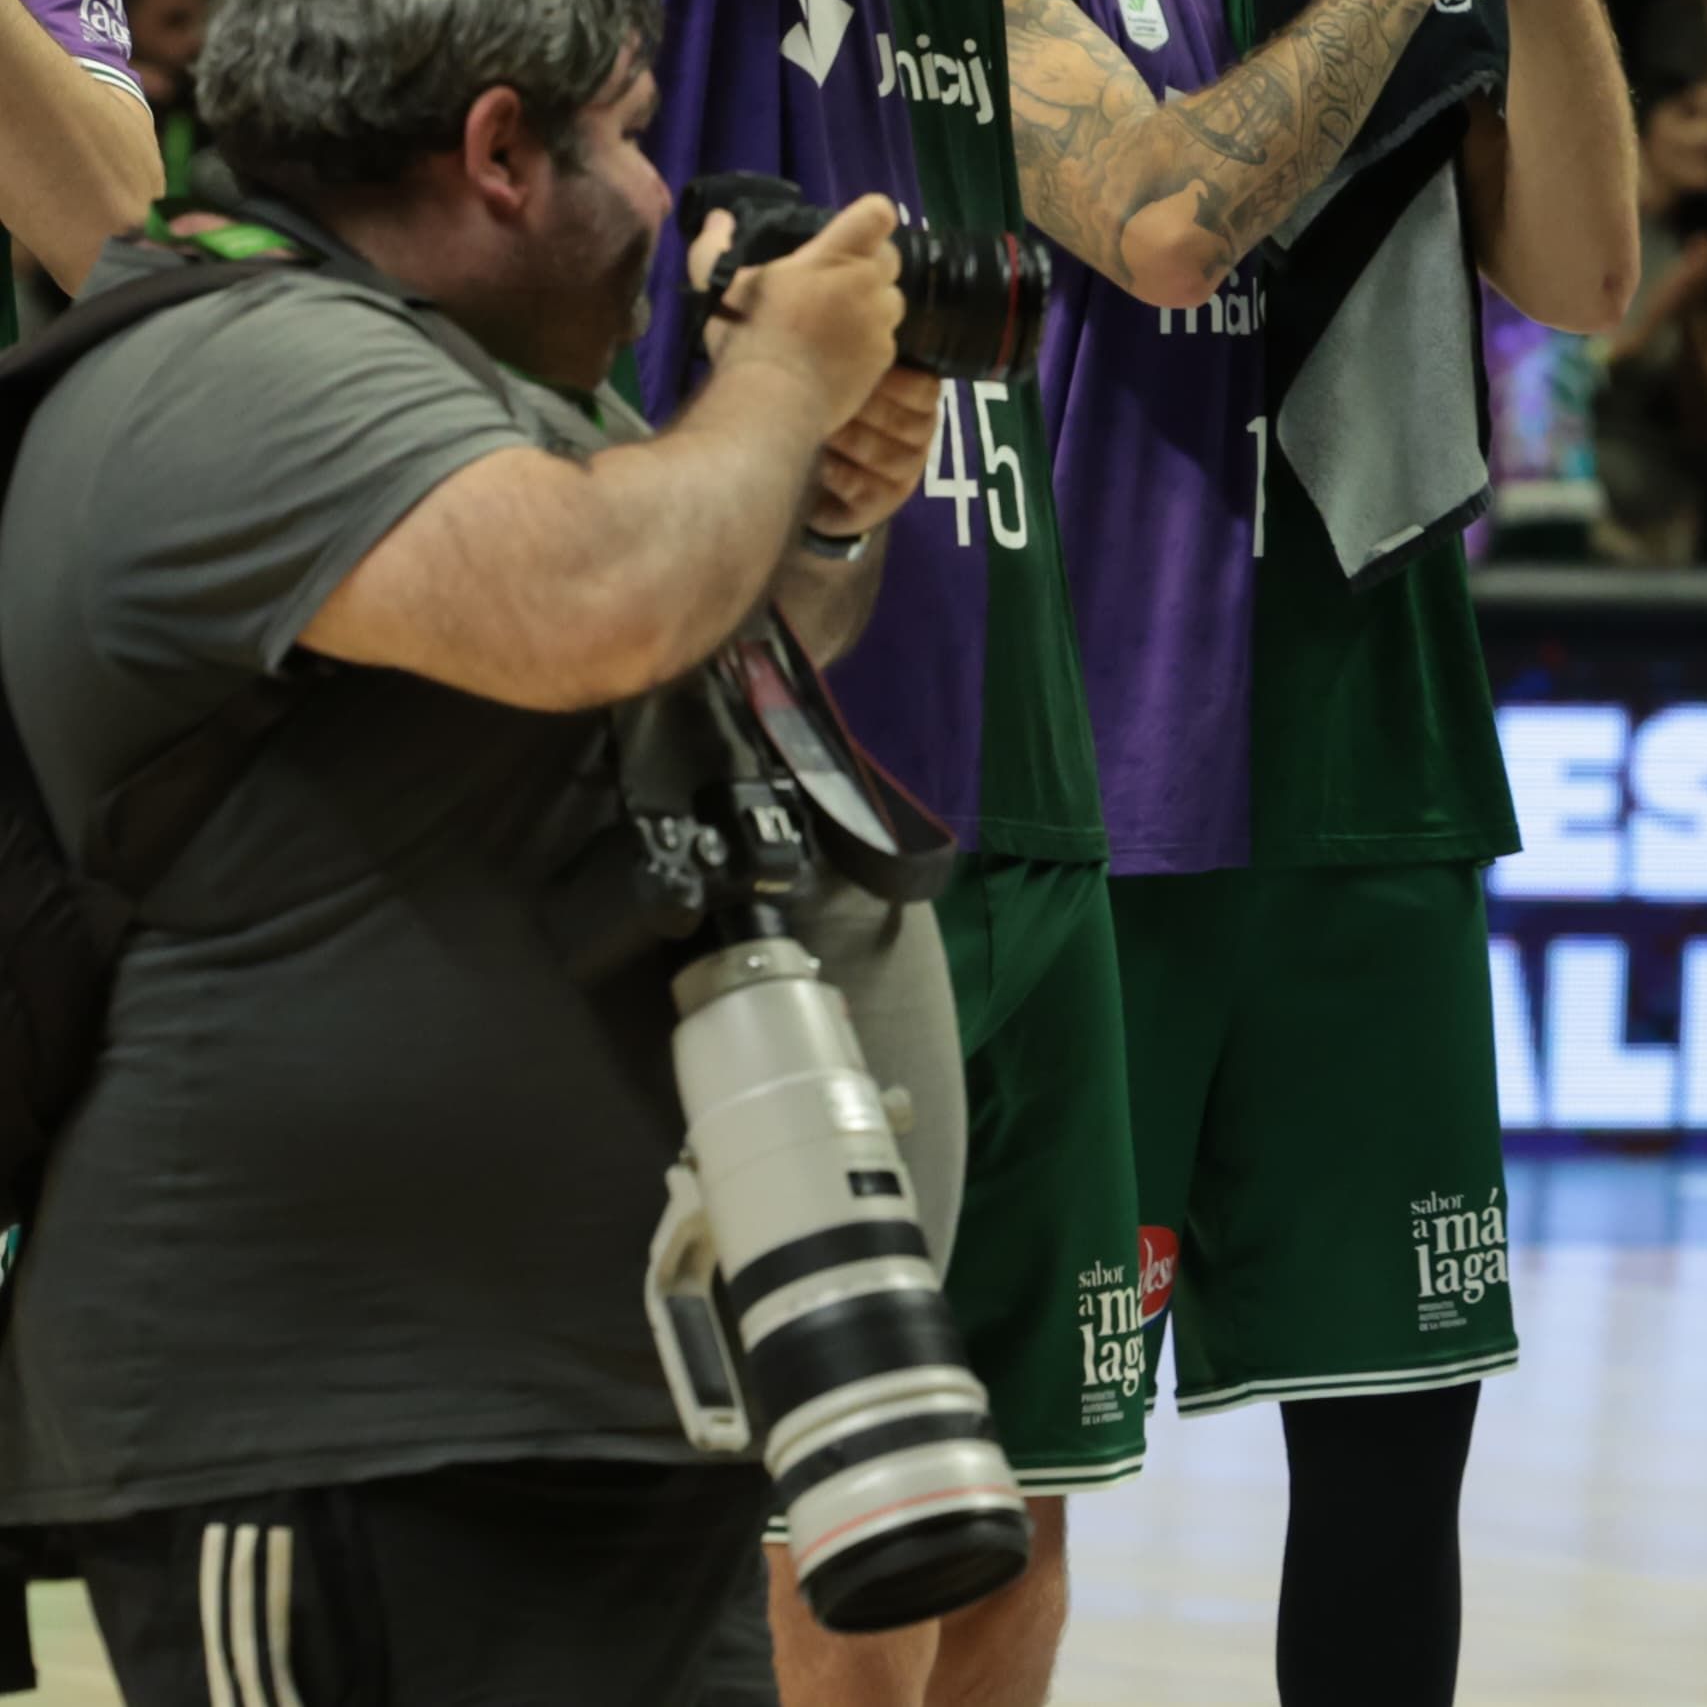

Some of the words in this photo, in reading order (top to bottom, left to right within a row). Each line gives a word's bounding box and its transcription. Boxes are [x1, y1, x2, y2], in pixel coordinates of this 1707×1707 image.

[924, 377, 1028, 550] 45
[1410, 1190, 1465, 1215] sabor
[1412, 1219, 1430, 1239] a
[1432, 1187, 1507, 1255] má
[1078, 1260, 1125, 1289] sabor
[1413, 1243, 1509, 1304] laga
[1078, 1294, 1096, 1318] a
